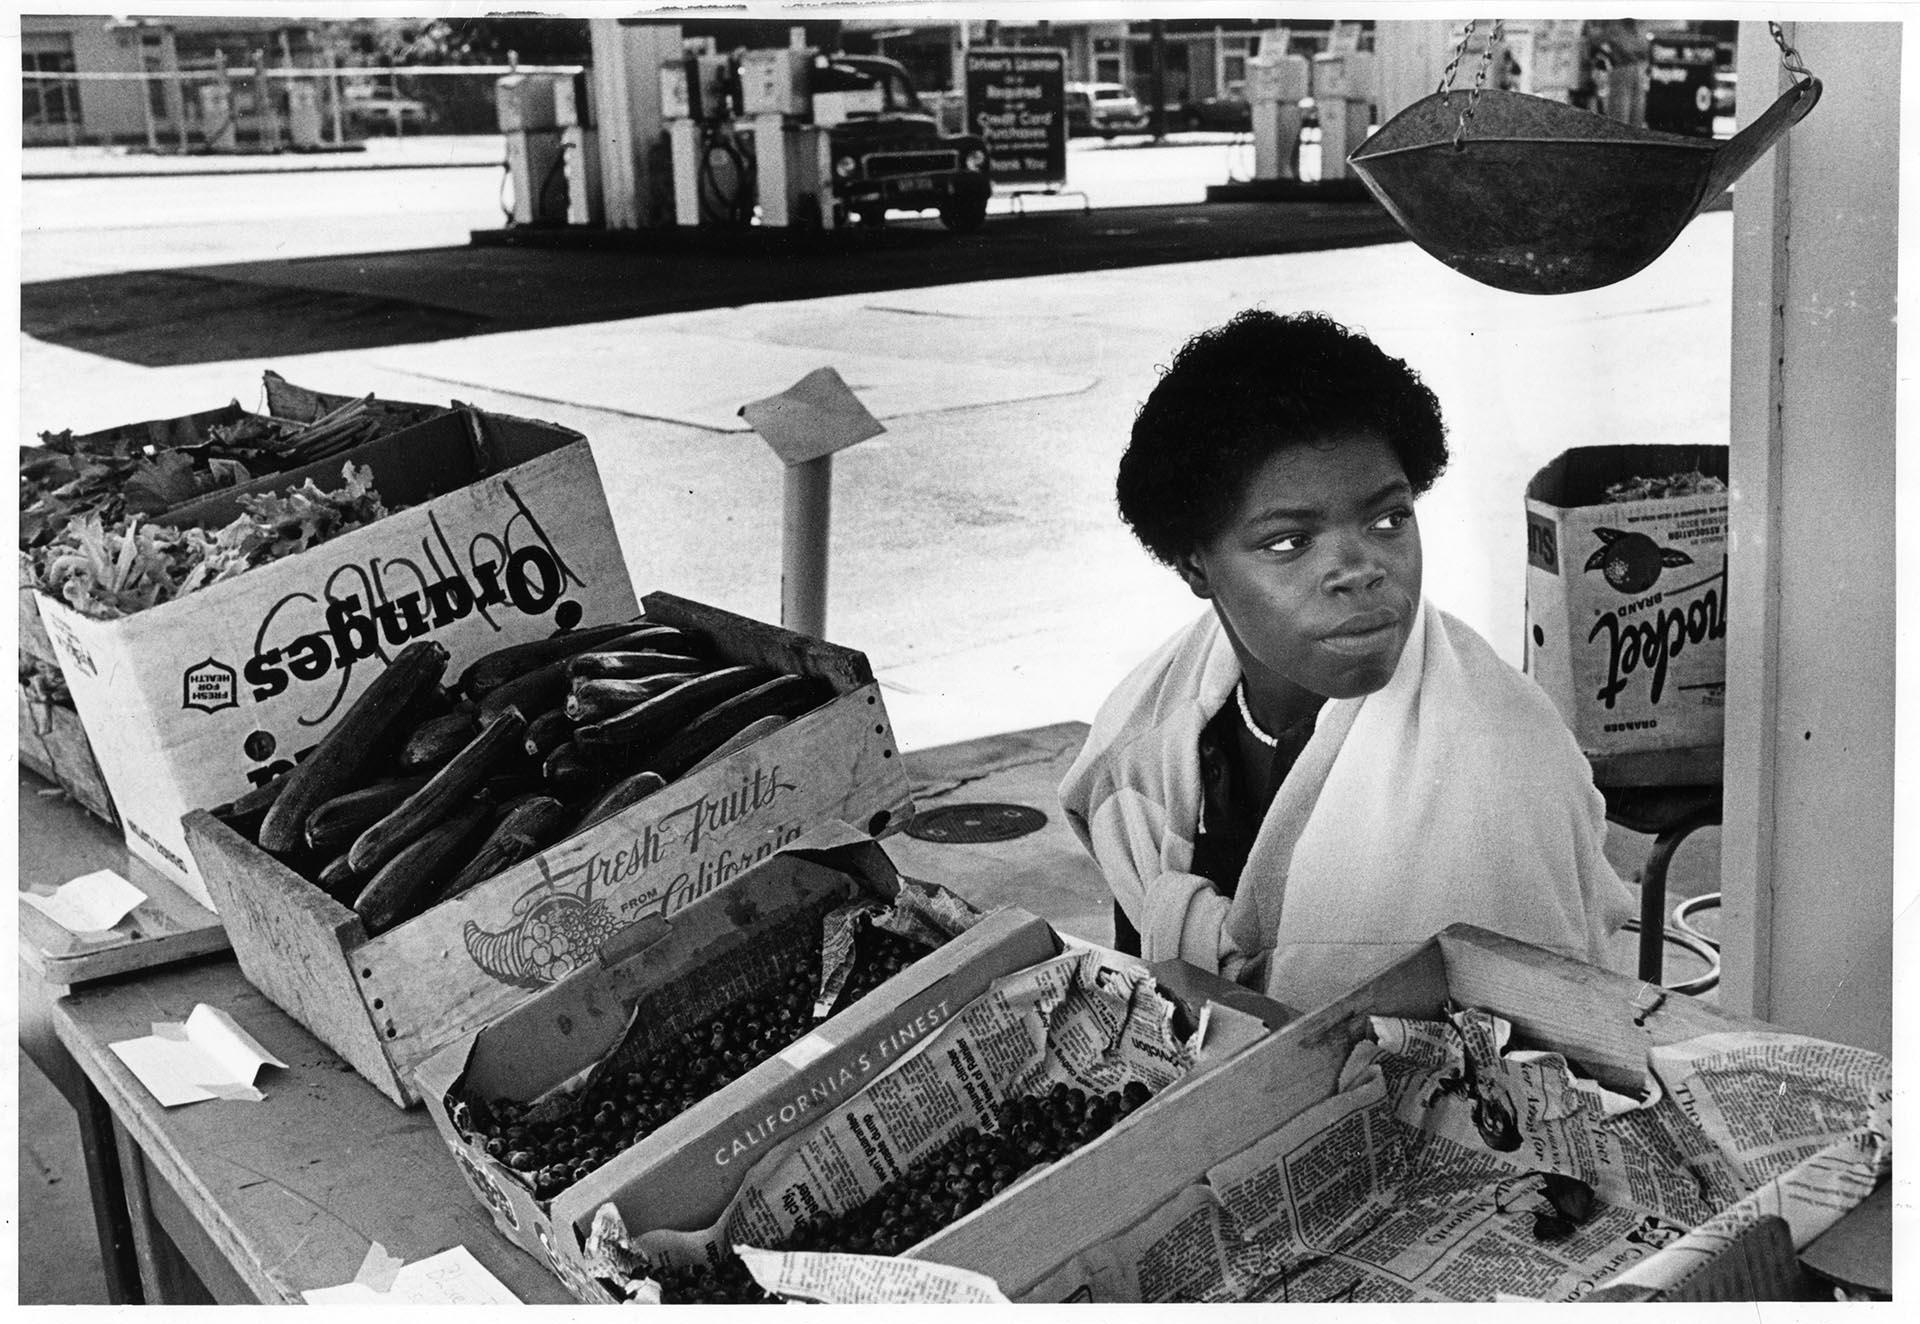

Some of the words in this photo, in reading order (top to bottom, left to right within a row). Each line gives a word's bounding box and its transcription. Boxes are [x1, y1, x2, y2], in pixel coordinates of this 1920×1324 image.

[1617, 592, 1663, 617] BRAND
[243, 543, 562, 703] Oranges
[191, 675, 229, 683] HEALTH
[198, 683, 220, 691] FOR
[193, 691, 229, 699] FRESH
[528, 824, 667, 917] Fresh
[659, 765, 797, 854] Fruits
[619, 888, 659, 915] FROM
[640, 825, 802, 920] California
[947, 1048, 968, 1081] climber
[972, 1069, 983, 1080] of
[714, 1053, 871, 1166] CALIFORNIA'S
[879, 1000, 950, 1059] FINEST
[964, 1083, 984, 1114] injured
[865, 1114, 881, 1139] dump
[1426, 1204, 1493, 1247] Majority
[1591, 1249, 1642, 1281] Carter
